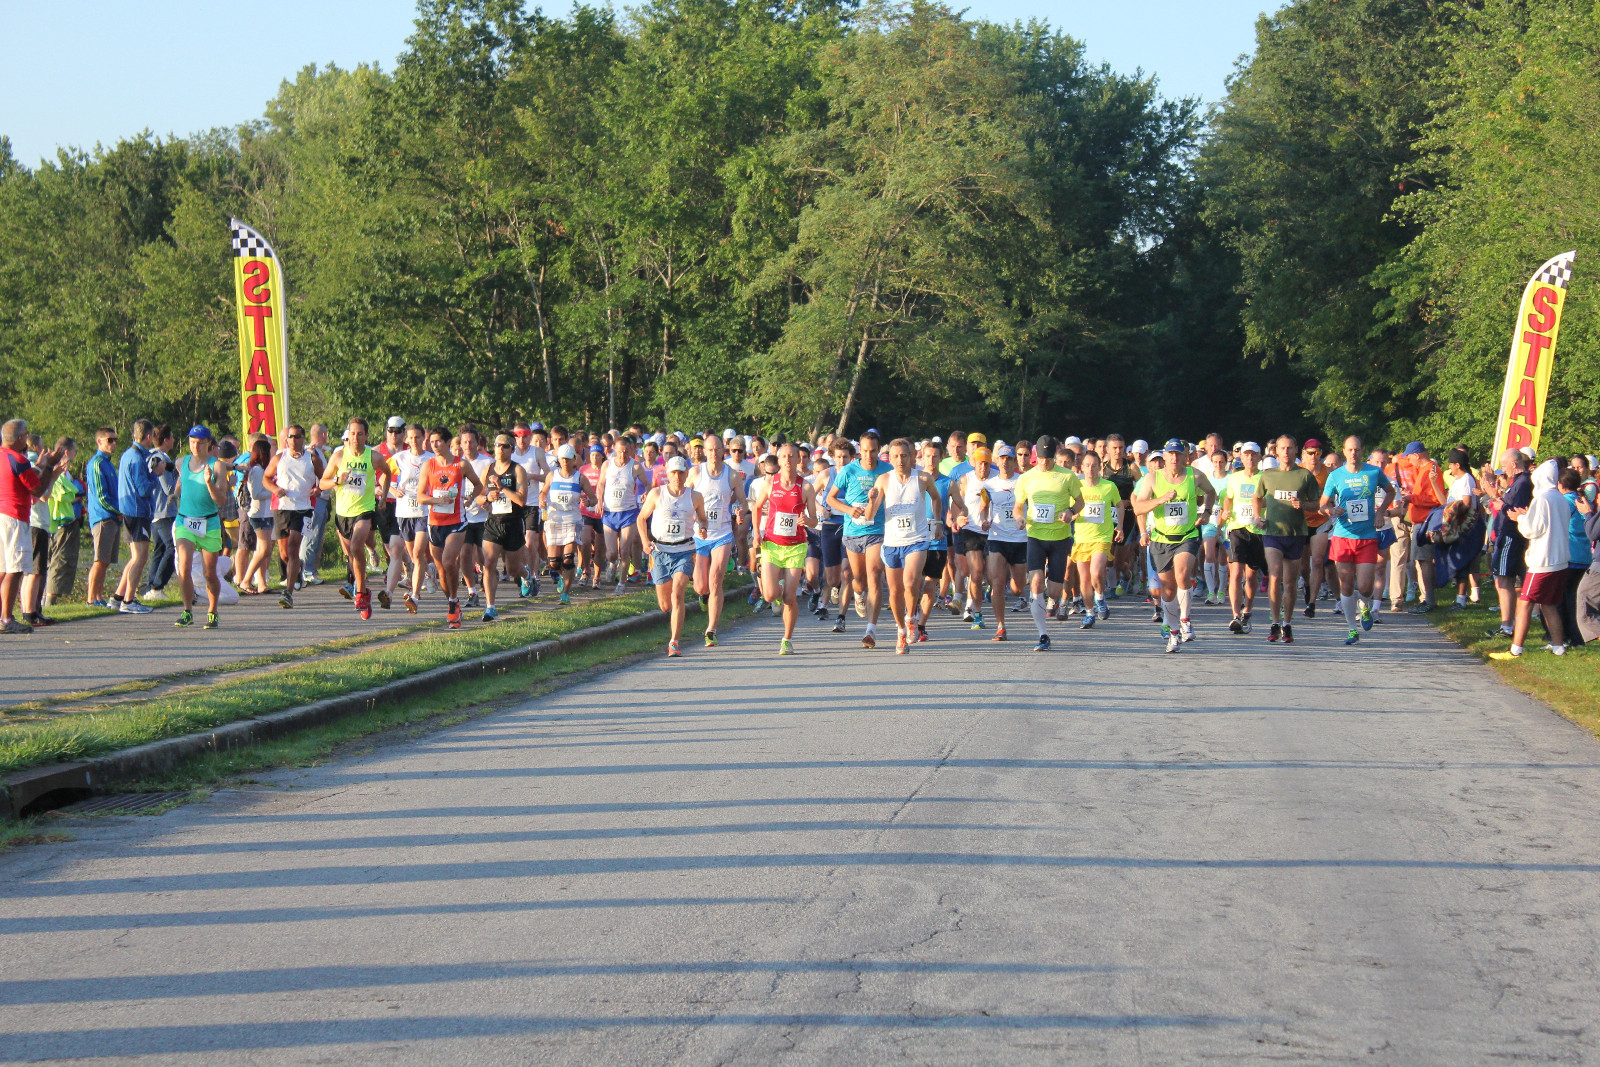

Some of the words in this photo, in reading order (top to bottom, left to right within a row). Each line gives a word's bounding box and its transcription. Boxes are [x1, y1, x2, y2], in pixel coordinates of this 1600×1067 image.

[347, 461, 367, 469] KJM
[349, 477, 362, 486] 245
[1089, 506, 1101, 515] 342
[1170, 507, 1183, 516] 250
[1241, 508, 1253, 516] 230
[1351, 504, 1364, 513] 252
[706, 511, 718, 520] 146
[1005, 510, 1014, 519] 32
[1037, 509, 1049, 518] 227
[189, 521, 202, 531] 287
[780, 517, 794, 527] 288
[897, 518, 911, 528] 215
[667, 524, 681, 534] 123
